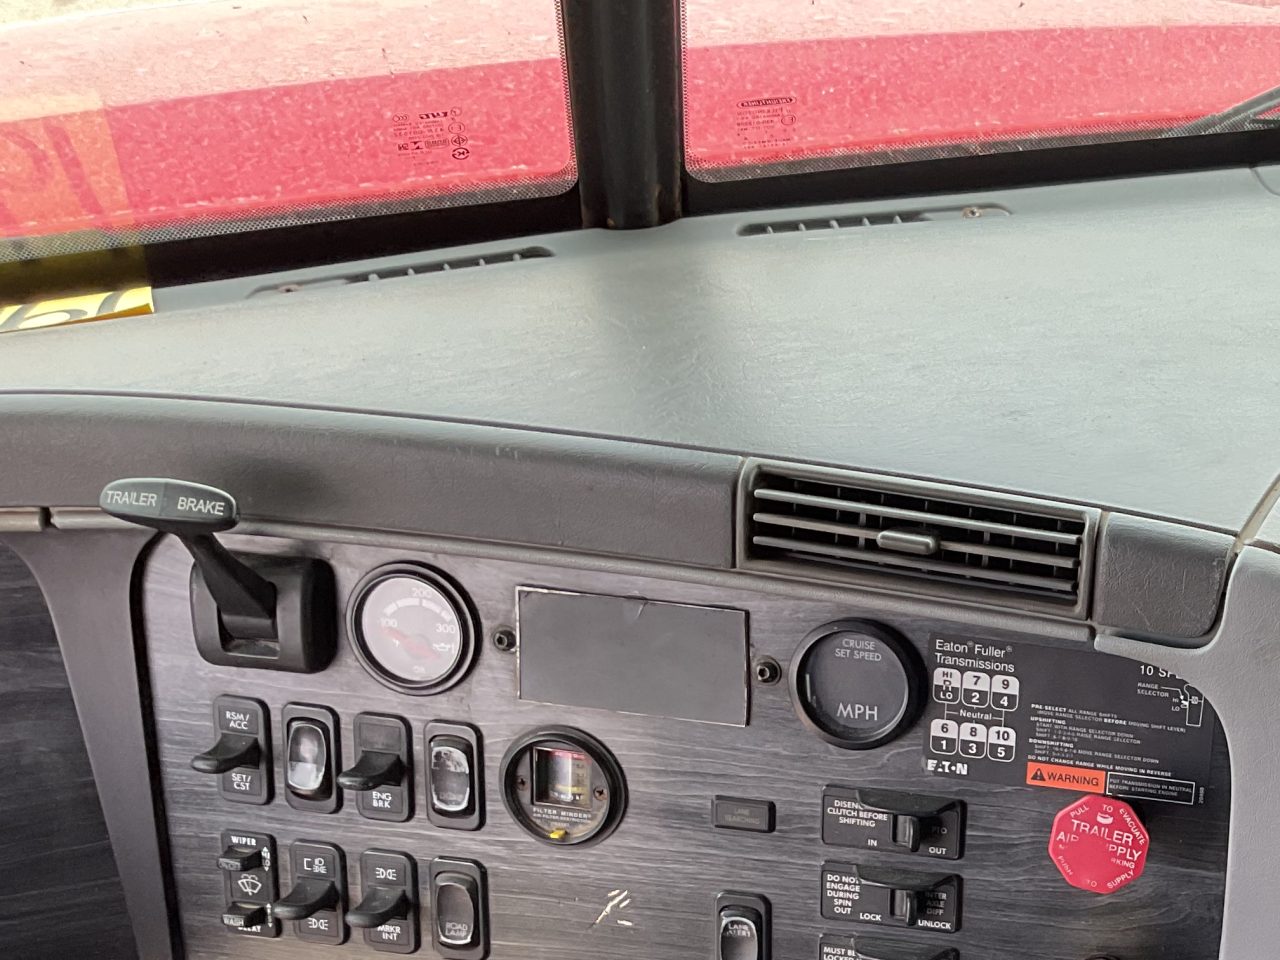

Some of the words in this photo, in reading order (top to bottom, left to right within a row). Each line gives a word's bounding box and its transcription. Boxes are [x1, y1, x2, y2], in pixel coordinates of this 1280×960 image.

[106, 490, 157, 508] TRAILER
[177, 496, 225, 516] BRAKE
[435, 623, 456, 634] 300
[842, 638, 876, 650] CRUISE
[834, 648, 851, 659] SET
[853, 650, 882, 662] SPEED
[935, 652, 1015, 672] Transmissions
[942, 671, 953, 679] HI
[1140, 664, 1154, 676] 10
[972, 675, 981, 685] 7
[1001, 679, 1010, 690] 9
[1137, 682, 1159, 690] RANGE
[940, 690, 953, 700] LO
[971, 692, 980, 703] 2
[1137, 689, 1169, 698] SELECTOR
[1000, 695, 1009, 707] 4
[837, 702, 878, 721] MPH
[960, 709, 992, 720] Neutral
[229, 719, 249, 730] ACC
[1030, 716, 1067, 725] UPSHIFTING
[941, 723, 949, 733] 6
[969, 727, 977, 737] 8
[995, 730, 1010, 741] 10
[940, 740, 947, 750] 1
[968, 743, 977, 754] 3
[1028, 738, 1075, 748] DOWNSHIFTING
[997, 747, 1006, 757] 5
[1050, 757, 1074, 765] CHANGE
[1115, 765, 1138, 773] MOVING
[1146, 769, 1172, 777] REVERSE
[1046, 771, 1099, 787] WARNING
[233, 780, 251, 790] CST
[372, 791, 392, 801] ENG
[372, 799, 392, 808] BRK
[532, 807, 558, 816] FILTER
[827, 807, 859, 818] CLUTCH
[859, 811, 888, 821] BEFORE
[838, 816, 876, 827] SHIFTING
[1069, 804, 1090, 818] PULL
[1102, 803, 1114, 813] TO
[1119, 808, 1146, 846] EVACUATE
[1071, 819, 1134, 846] TRAILER
[230, 835, 257, 846] WIPER
[867, 839, 878, 847] IN
[928, 846, 947, 855] OUT
[826, 874, 841, 882] DO
[1106, 869, 1135, 889] SUPPLY
[826, 882, 861, 893] ENGAGE
[826, 890, 860, 900] DURING
[833, 898, 852, 907] SPIN
[833, 906, 852, 915] OUT
[223, 916, 244, 927] WASH
[859, 913, 882, 922] LOCK
[917, 919, 952, 930] UNLOCK
[382, 932, 398, 941] INT
[823, 946, 846, 955] MUST
